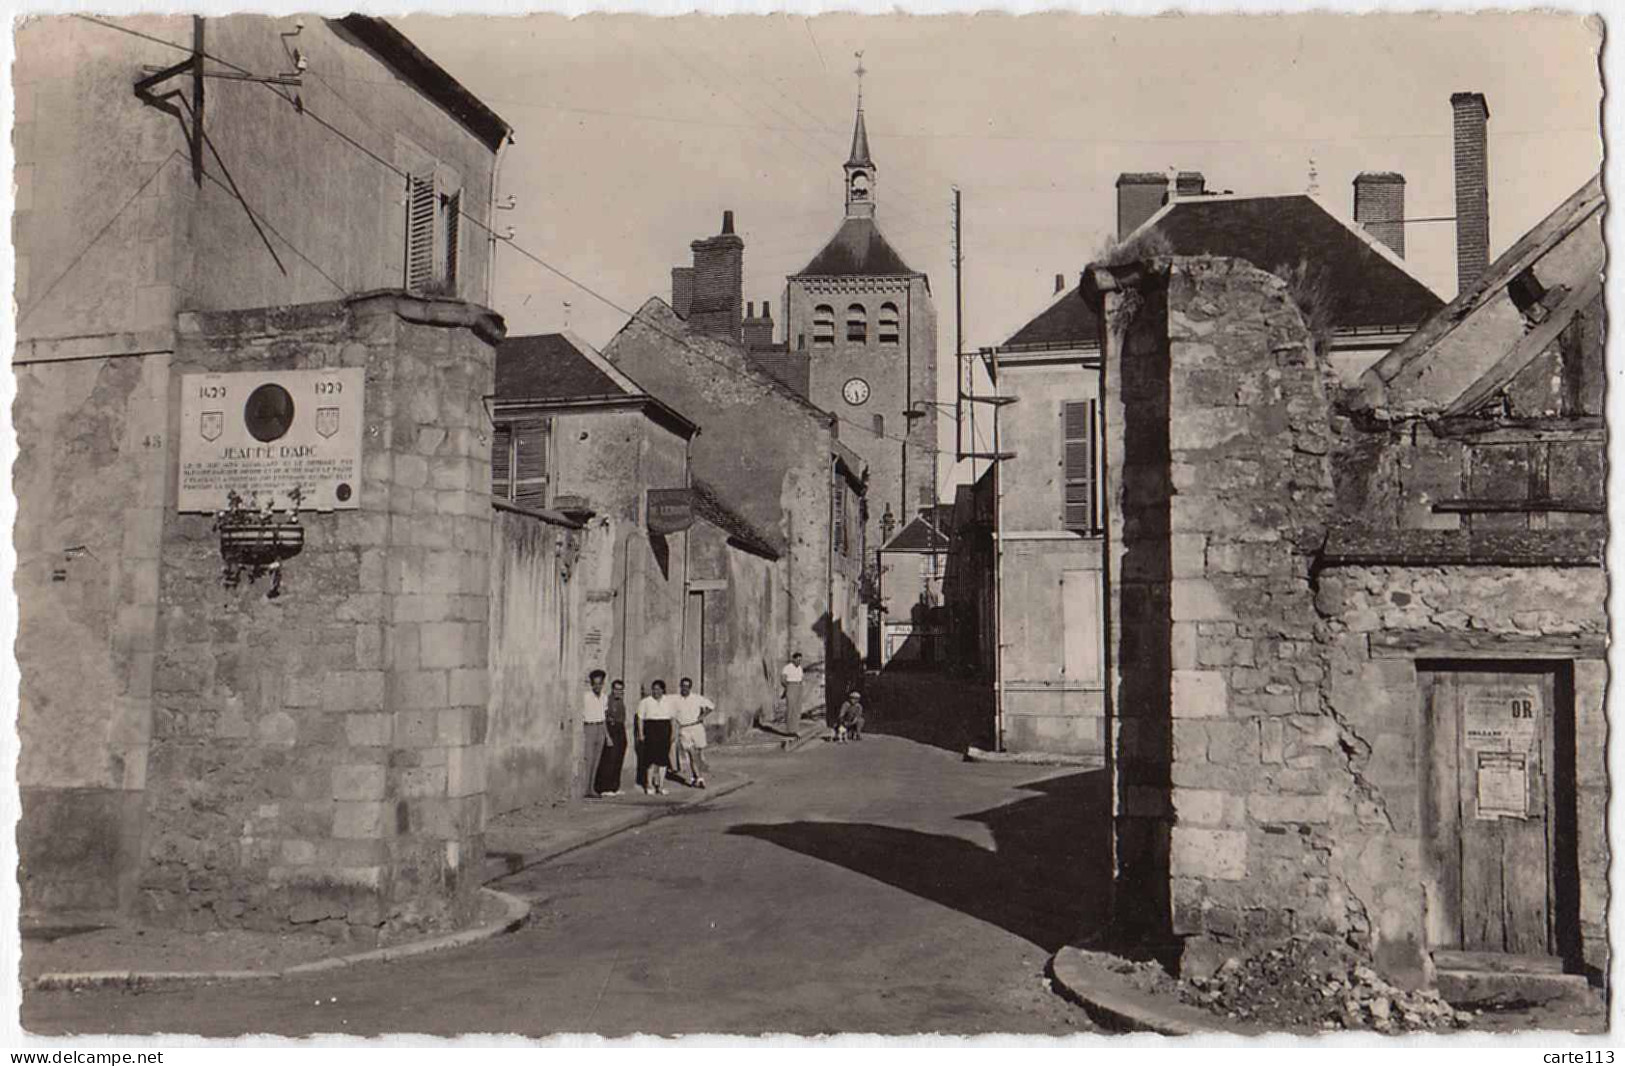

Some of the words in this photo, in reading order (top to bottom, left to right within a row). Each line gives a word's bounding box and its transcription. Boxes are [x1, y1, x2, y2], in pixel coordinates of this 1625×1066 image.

[199, 386, 227, 399] 1429
[314, 382, 343, 395] 1929
[1512, 700, 1532, 719] OR
